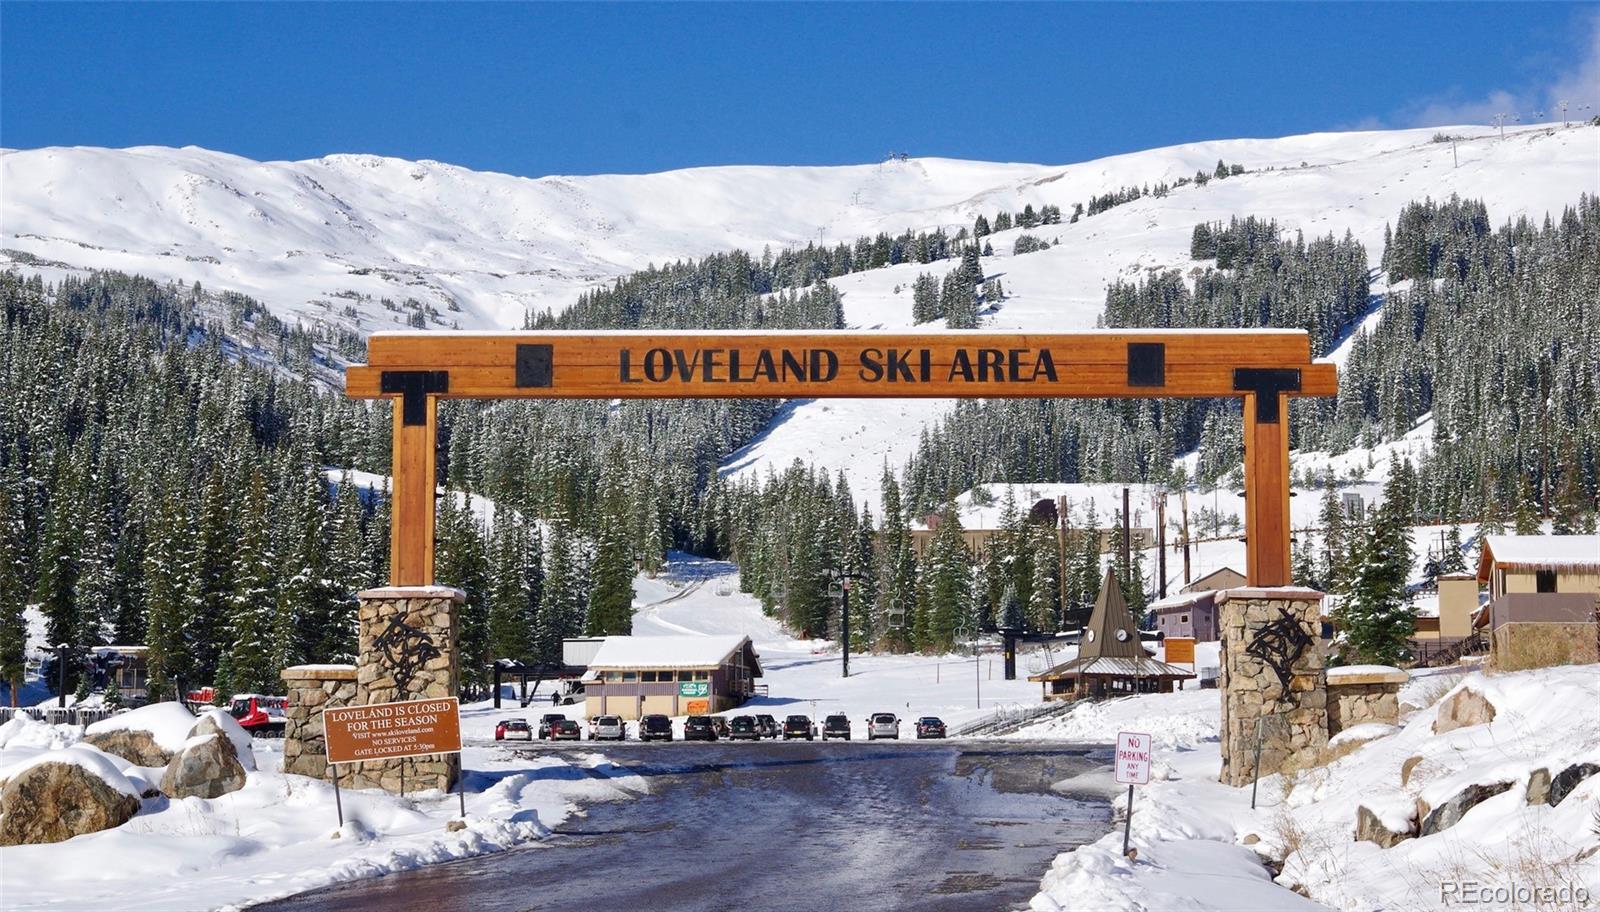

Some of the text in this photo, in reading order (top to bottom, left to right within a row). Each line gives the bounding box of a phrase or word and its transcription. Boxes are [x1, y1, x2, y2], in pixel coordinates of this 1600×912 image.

[620, 348, 1058, 382] LOVELAND SKI AREA
[332, 702, 450, 722] LOVELAND IS CLOSED
[348, 714, 438, 732] FOR THE SEASON
[372, 727, 434, 738] www.skiloveland.com
[384, 736, 416, 746] SERVICES
[1128, 738, 1140, 748] NO
[374, 746, 402, 755] LOCKED
[414, 743, 435, 752] 5:30pm
[1119, 750, 1148, 762] PARKING
